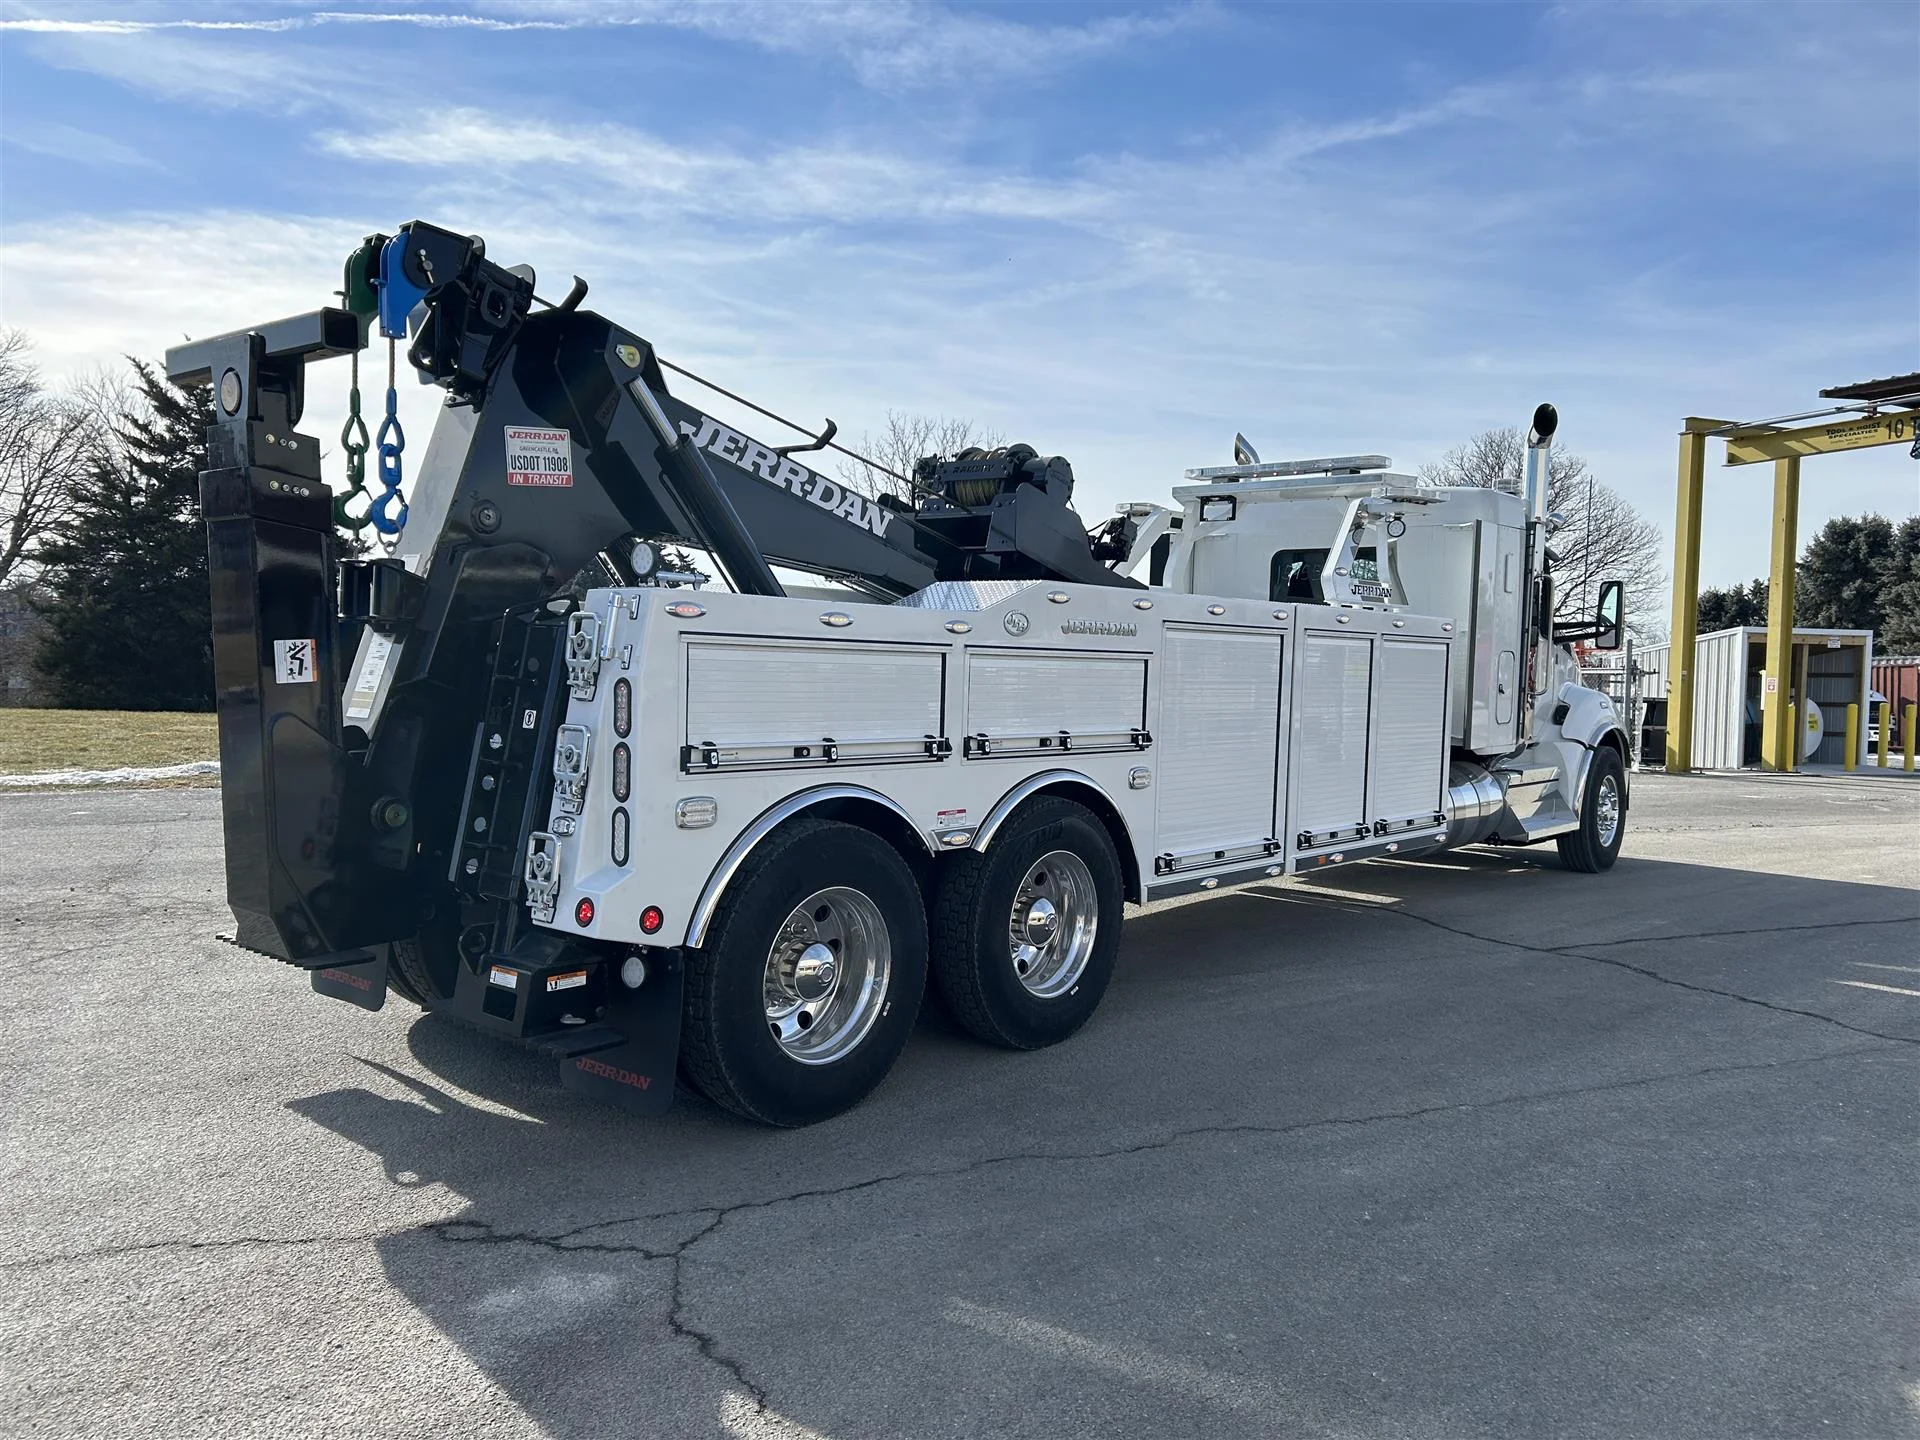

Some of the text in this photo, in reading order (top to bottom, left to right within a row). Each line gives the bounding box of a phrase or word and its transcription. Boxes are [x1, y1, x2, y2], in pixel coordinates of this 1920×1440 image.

[1886, 418, 1904, 440] 10
[510, 454, 568, 472] USDOT 11908
[512, 473, 568, 485] IN TRANSIT
